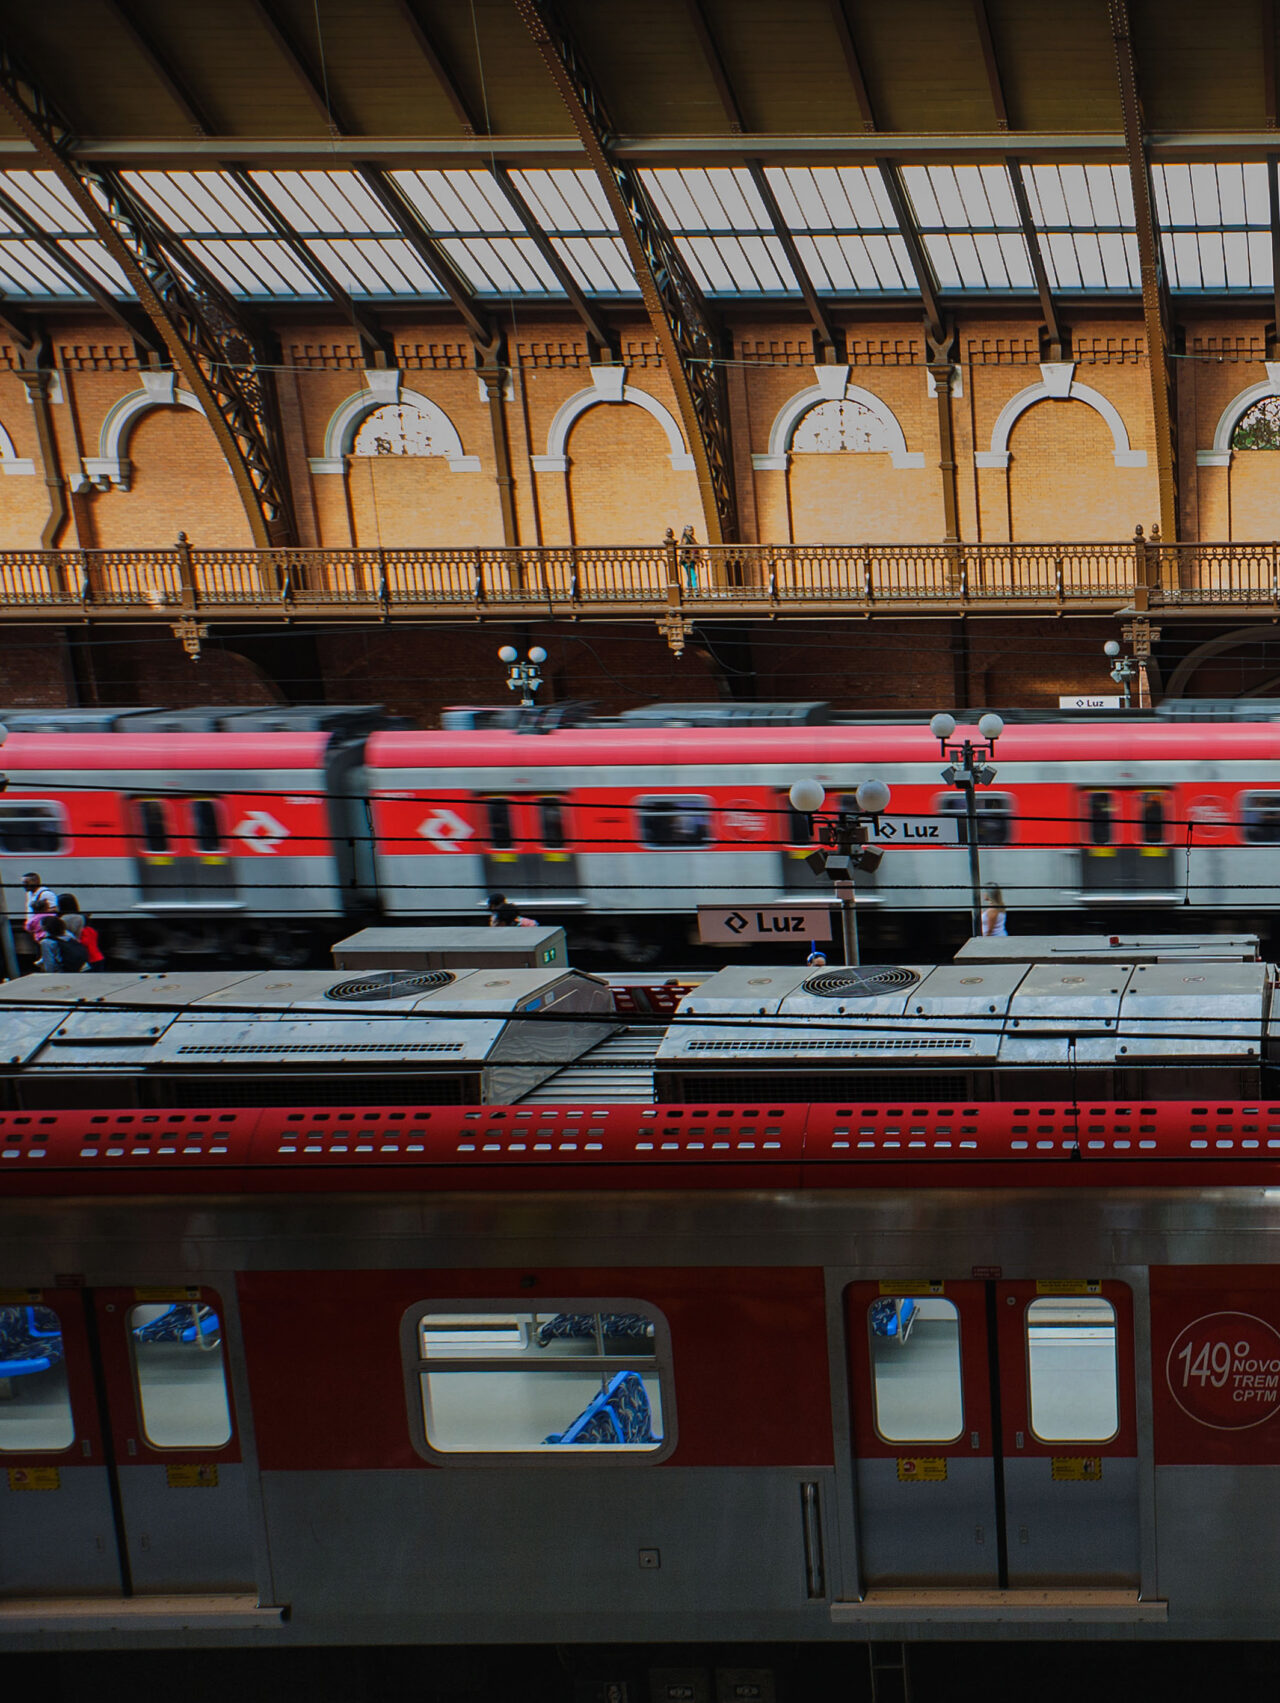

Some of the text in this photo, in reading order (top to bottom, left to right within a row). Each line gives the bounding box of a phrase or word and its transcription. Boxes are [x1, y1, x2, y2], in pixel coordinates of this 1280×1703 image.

[1087, 699, 1104, 707] Luz
[903, 822, 939, 838] Luz
[756, 912, 806, 933] Luz
[1232, 1374, 1280, 1388] TREM
[1232, 1389, 1278, 1402] CPTM
